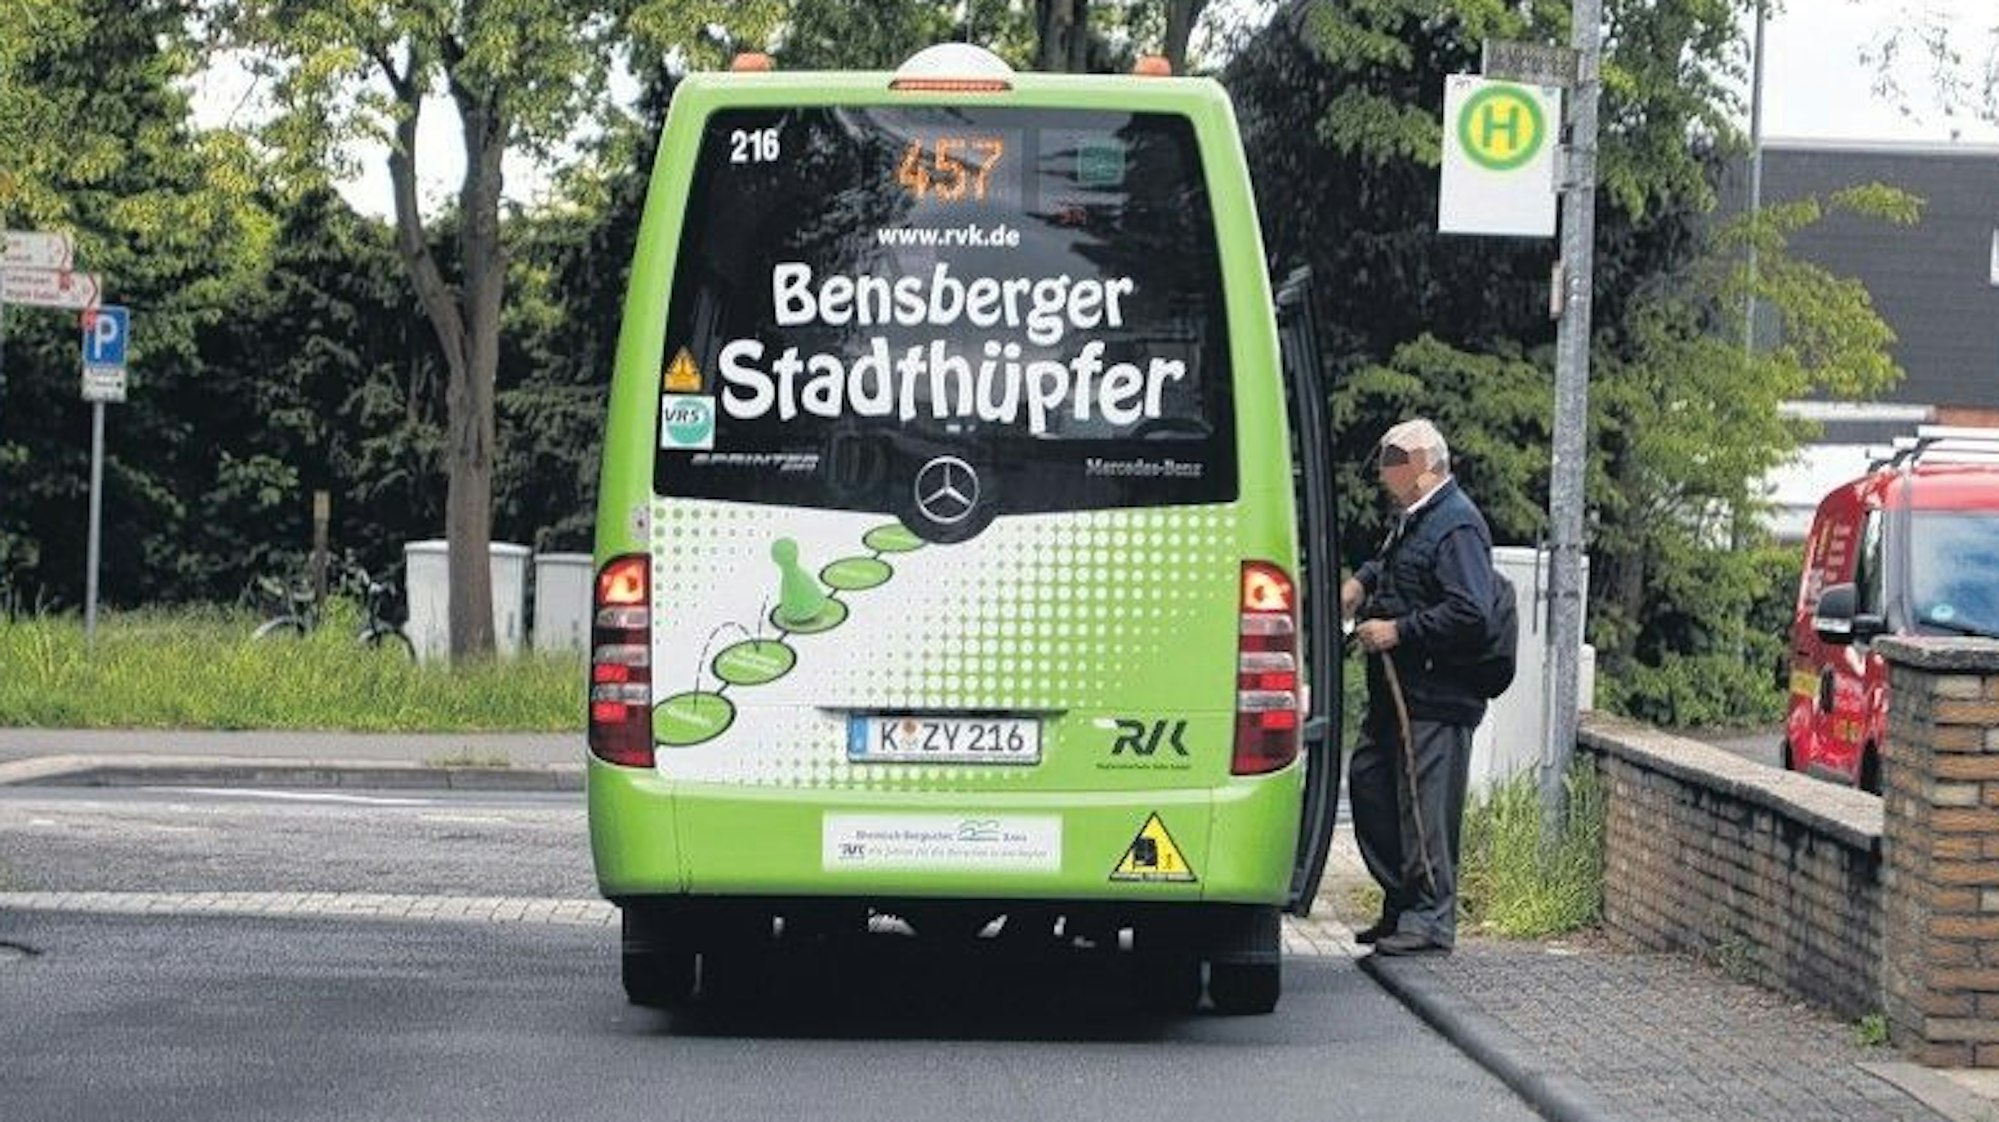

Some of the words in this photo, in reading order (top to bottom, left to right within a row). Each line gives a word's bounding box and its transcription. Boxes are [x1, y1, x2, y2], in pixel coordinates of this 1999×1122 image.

[730, 129, 780, 163] 216
[1482, 104, 1520, 150] H
[896, 136, 1005, 205] 457
[877, 225, 1021, 247] www.rvk.de
[773, 262, 1134, 346] Bensberger
[94, 315, 118, 359] P
[718, 337, 1186, 434] Stadthüpfer
[665, 407, 699, 422] VRS
[1085, 458, 1203, 477] Mercedes-Benz
[881, 722, 898, 751] K
[923, 724, 960, 751] ZY
[968, 724, 1025, 752] 216
